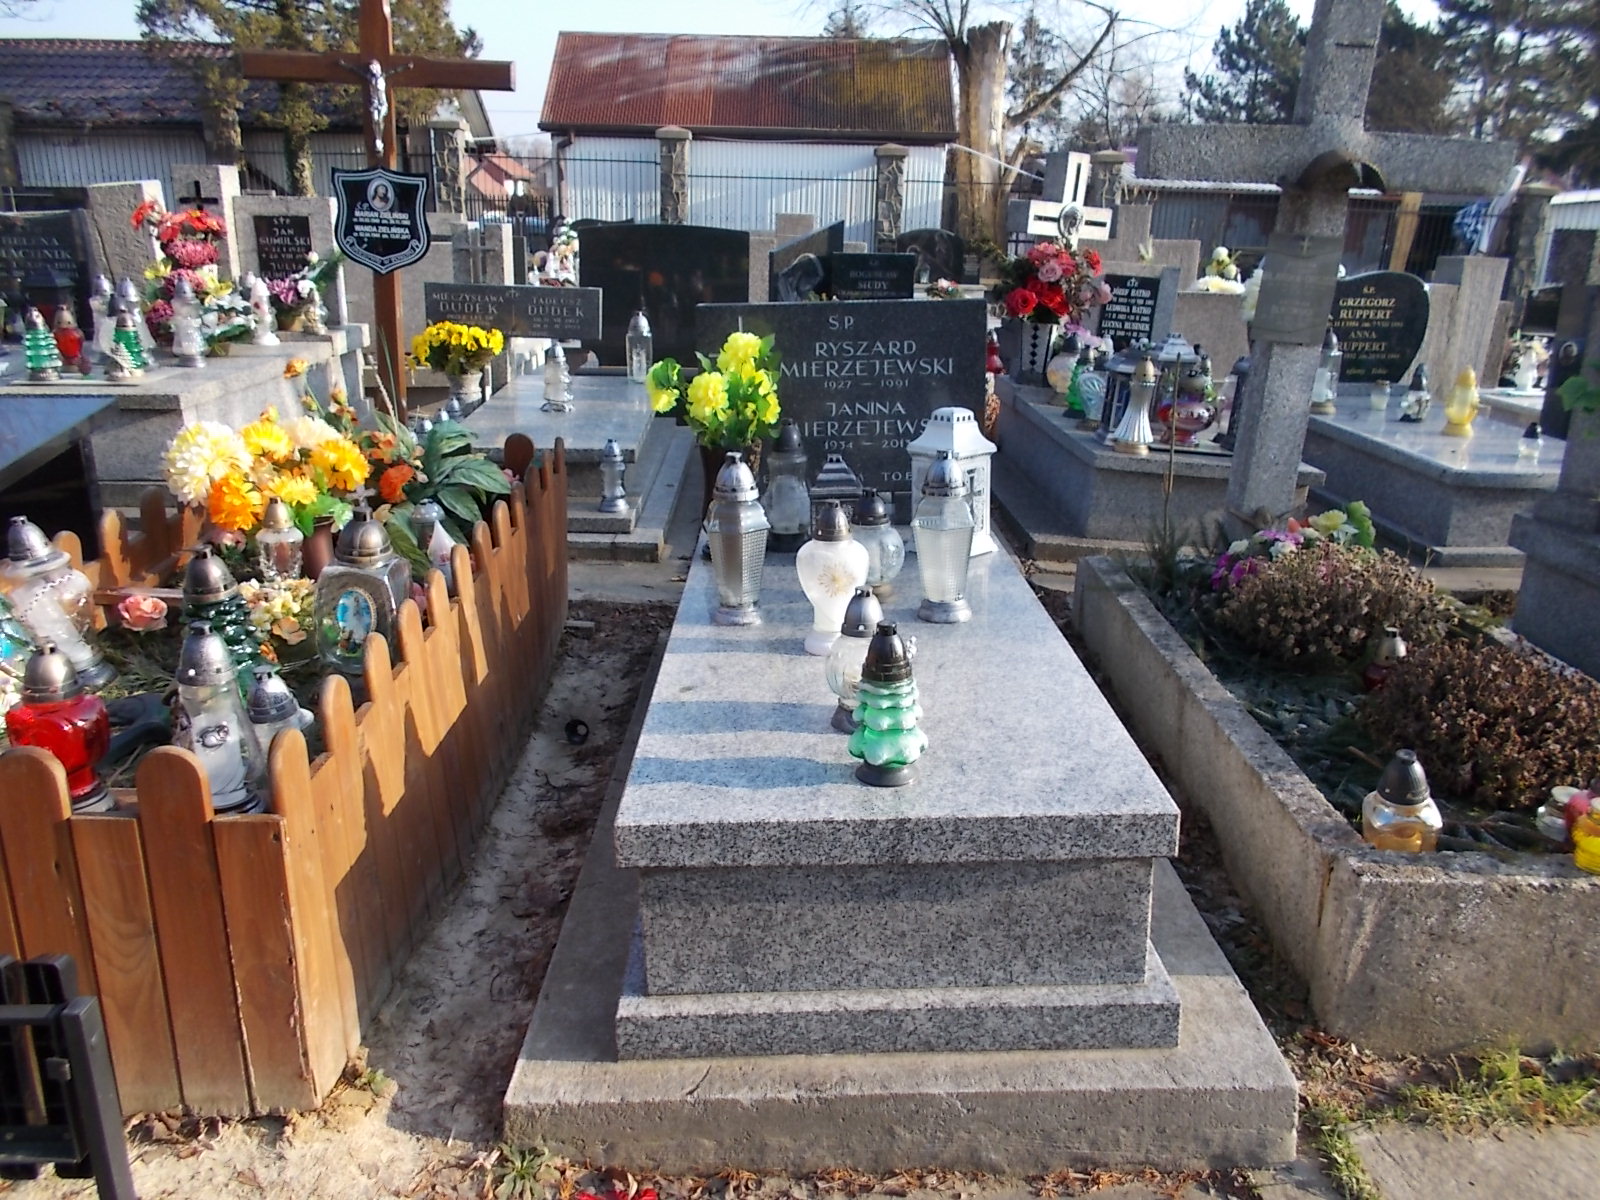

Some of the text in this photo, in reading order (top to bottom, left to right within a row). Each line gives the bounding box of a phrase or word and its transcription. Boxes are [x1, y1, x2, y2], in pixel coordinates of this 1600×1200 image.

[440, 301, 498, 314] DUDEK
[1339, 298, 1396, 307] GRZEGORZ
[528, 305, 584, 317] DUDEK
[1339, 309, 1393, 320] RUPPERT
[1349, 330, 1377, 339] ANNA
[815, 340, 917, 357] RYSZARD
[779, 357, 954, 378] MIERZEJEWSKI
[824, 379, 852, 389] 1927
[880, 379, 909, 388] 1991
[826, 401, 906, 417] JANINA
[797, 418, 930, 437] IERZEJEWS
